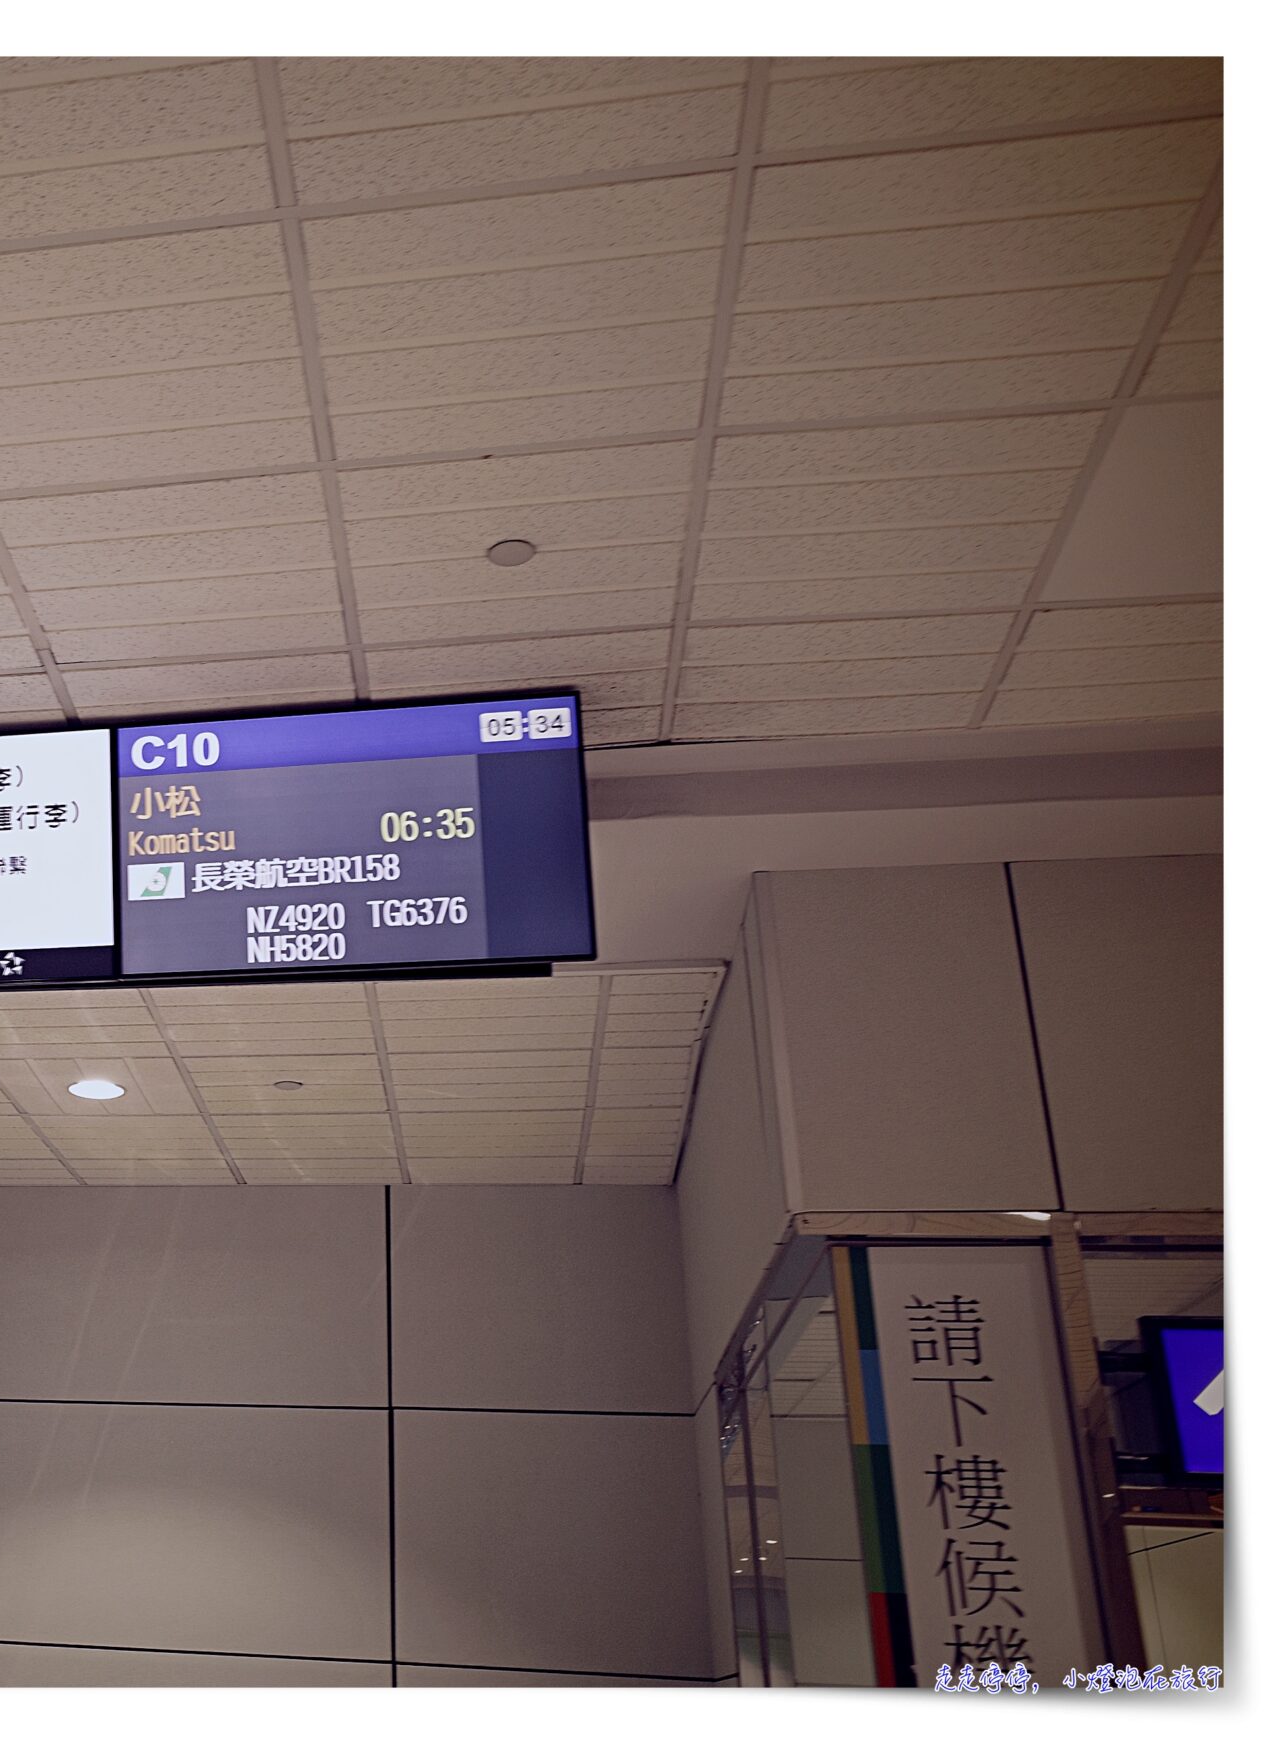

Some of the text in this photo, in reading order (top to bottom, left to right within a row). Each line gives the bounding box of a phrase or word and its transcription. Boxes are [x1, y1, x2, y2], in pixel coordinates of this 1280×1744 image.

[486, 712, 566, 738] 05:34
[129, 731, 220, 770] C10
[130, 786, 200, 819] 小松
[128, 827, 235, 856] Komatsu
[380, 807, 475, 843] 06:35
[191, 853, 401, 893] 長榮航空BR158
[246, 896, 469, 934] NZ4920 TG6376
[246, 931, 347, 963] NH5820
